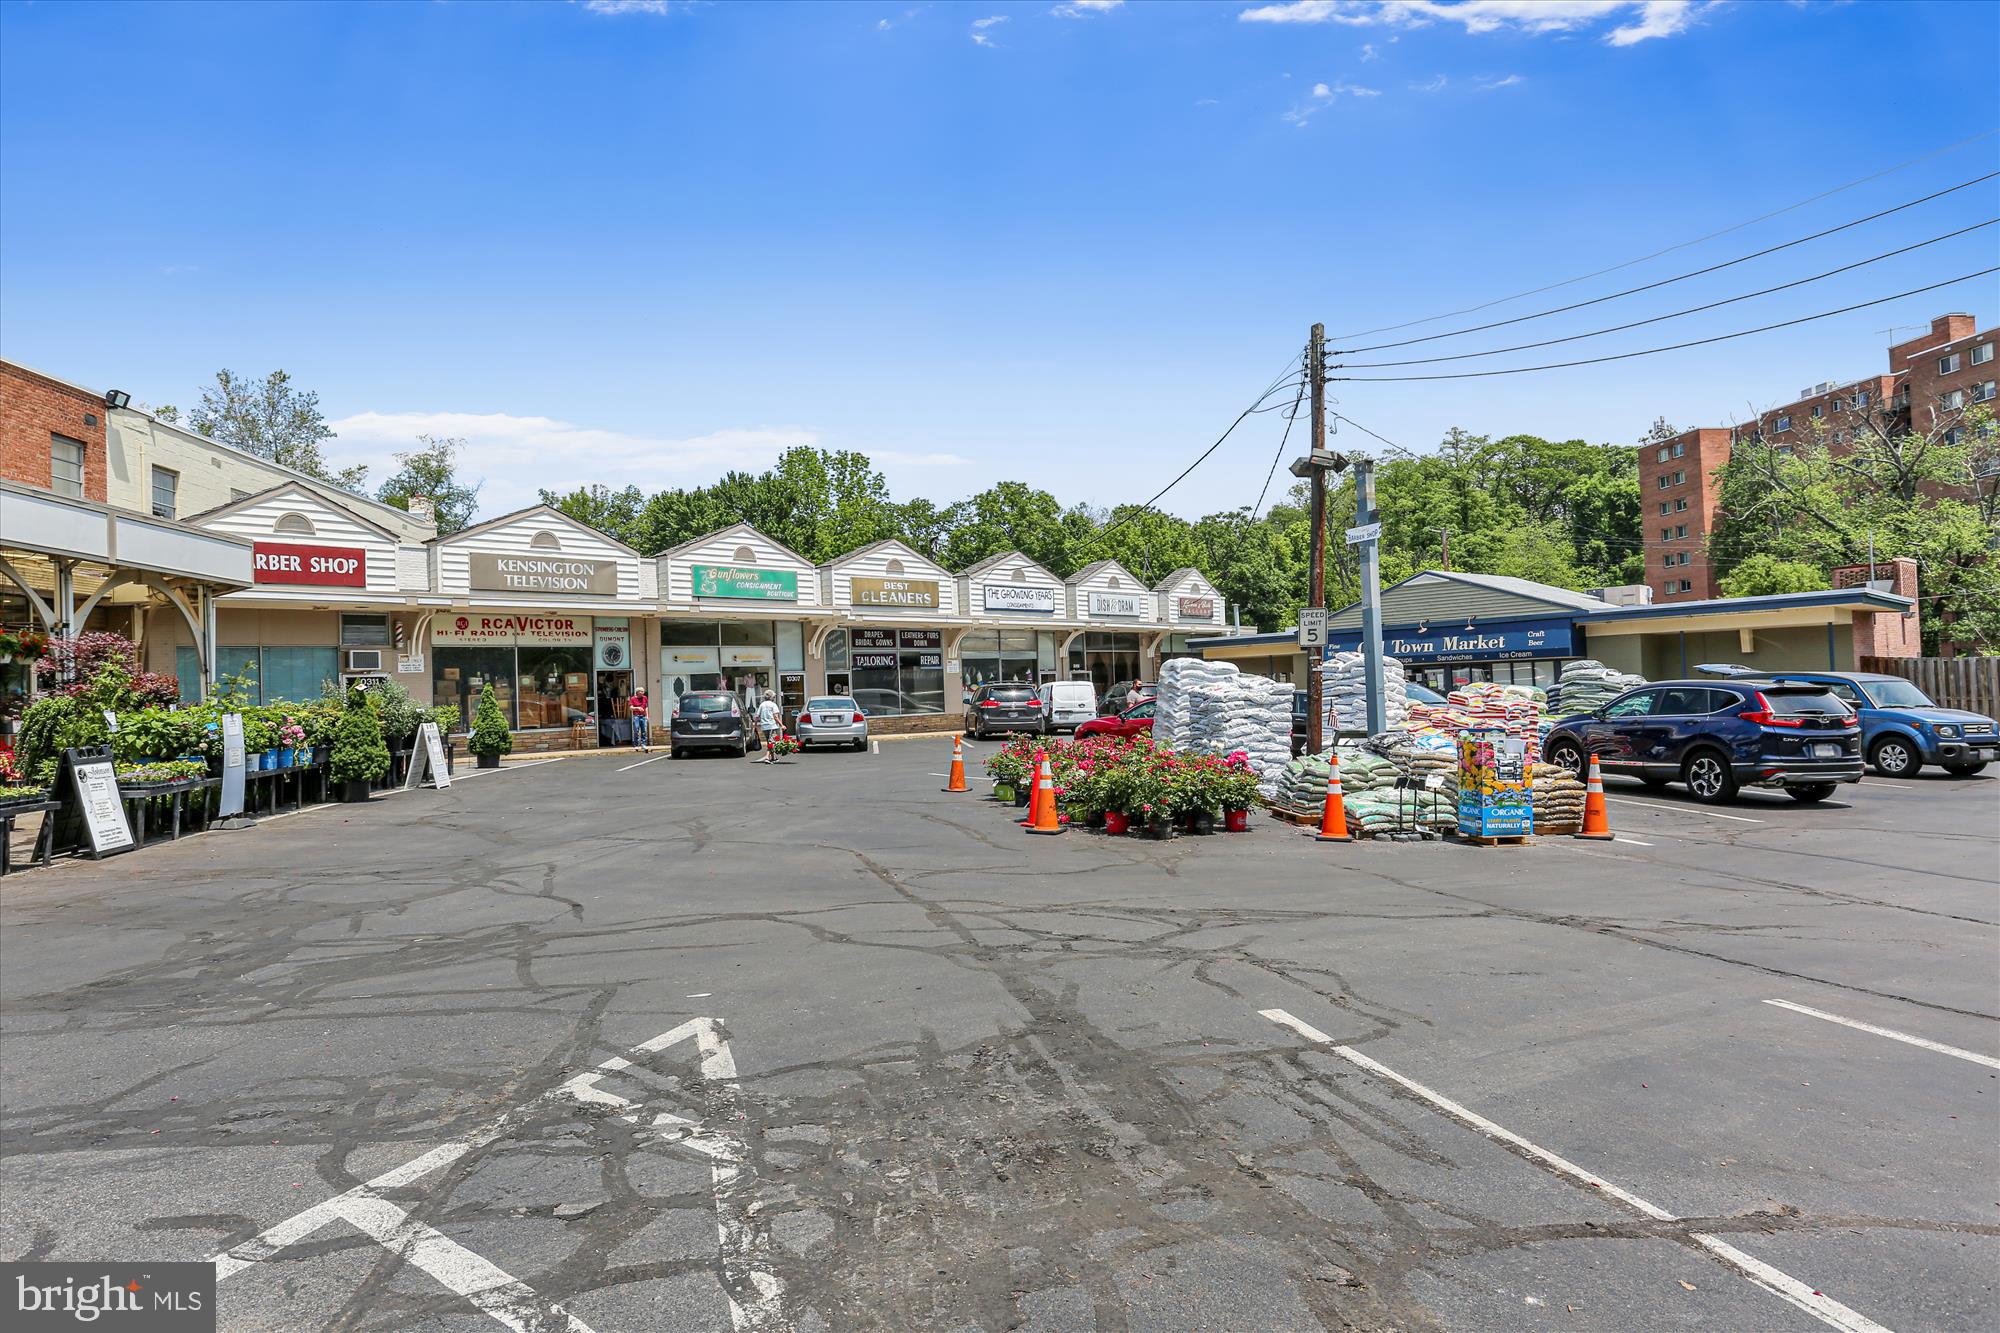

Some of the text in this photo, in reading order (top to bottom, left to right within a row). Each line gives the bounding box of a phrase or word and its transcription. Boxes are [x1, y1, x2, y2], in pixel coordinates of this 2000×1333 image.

[253, 553, 358, 575] RBER SHOP
[497, 559, 594, 576] KENSINGTON
[504, 574, 588, 590] TELEVISION
[736, 581, 782, 590] CONSIGNMENT
[884, 581, 909, 590] BEST
[861, 591, 932, 604] CLEANERS
[987, 588, 1052, 601] THE GROWING YEARS
[1097, 599, 1110, 611] DISH
[1118, 600, 1134, 612] DRAM
[1301, 611, 1325, 619] SPEED
[515, 616, 574, 632] VICTOR
[531, 630, 589, 638] TELEVISION
[1307, 628, 1319, 643] 5
[1528, 630, 1545, 638] Craft
[1391, 637, 1434, 654] Town
[1443, 634, 1506, 652] Market
[1528, 638, 1544, 647] Beer
[856, 655, 894, 667] TAILORING
[920, 655, 940, 666] REPAIR
[1436, 653, 1473, 662] Sandwiches
[1508, 650, 1533, 659] Cream
[1491, 808, 1526, 816] ORGANIC
